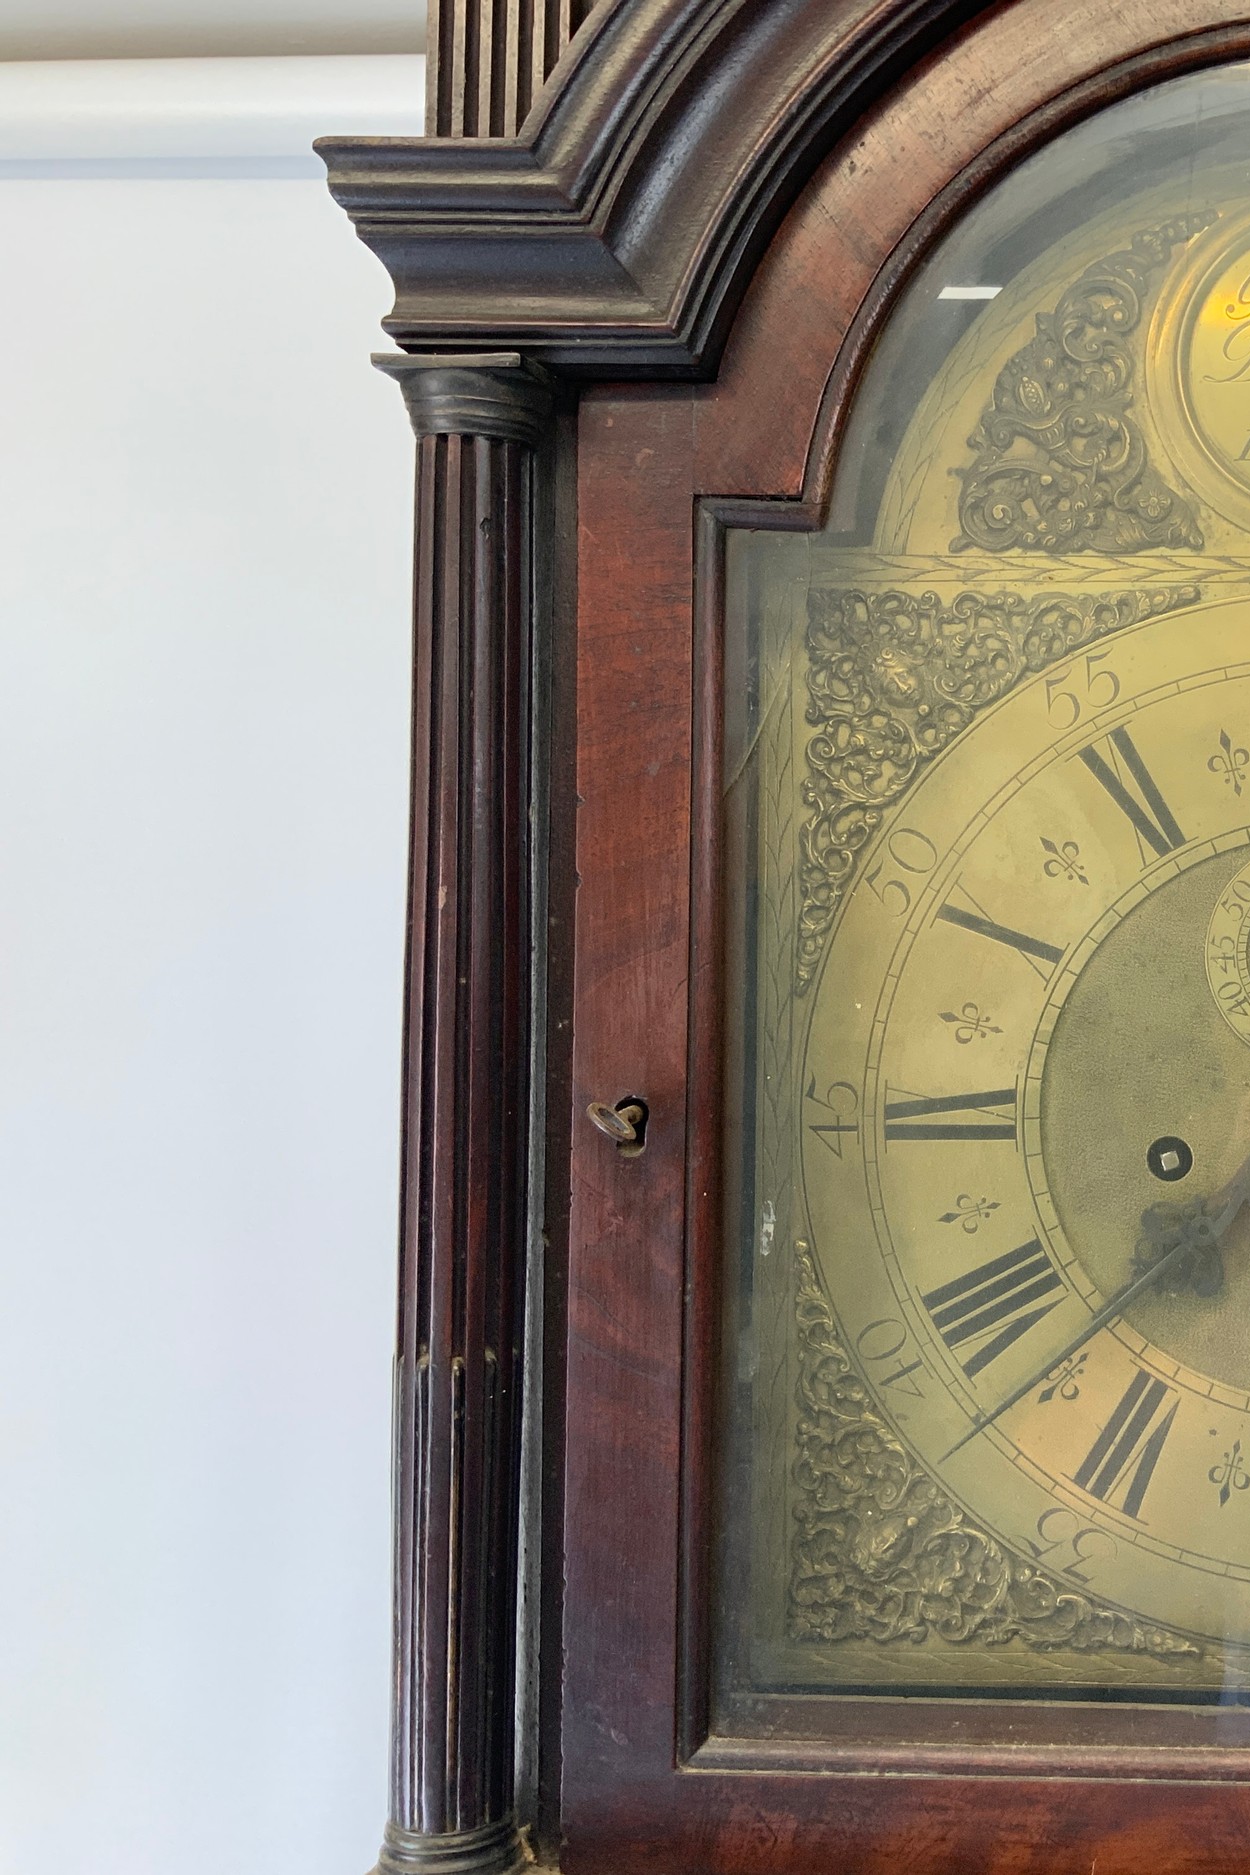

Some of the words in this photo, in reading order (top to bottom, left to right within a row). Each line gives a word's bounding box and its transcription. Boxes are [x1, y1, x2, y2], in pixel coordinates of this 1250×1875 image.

[1045, 648, 1121, 730] 55
[1066, 719, 1198, 872] XI
[866, 828, 937, 917] 50
[930, 872, 1071, 991] X
[1210, 935, 1236, 974] 45
[805, 1077, 860, 1161] 45
[884, 1074, 1018, 1152] IX
[915, 1225, 1069, 1389] VIII
[856, 1318, 934, 1399] 40
[1061, 1359, 1181, 1526] VII
[1012, 1506, 1118, 1583] 35
